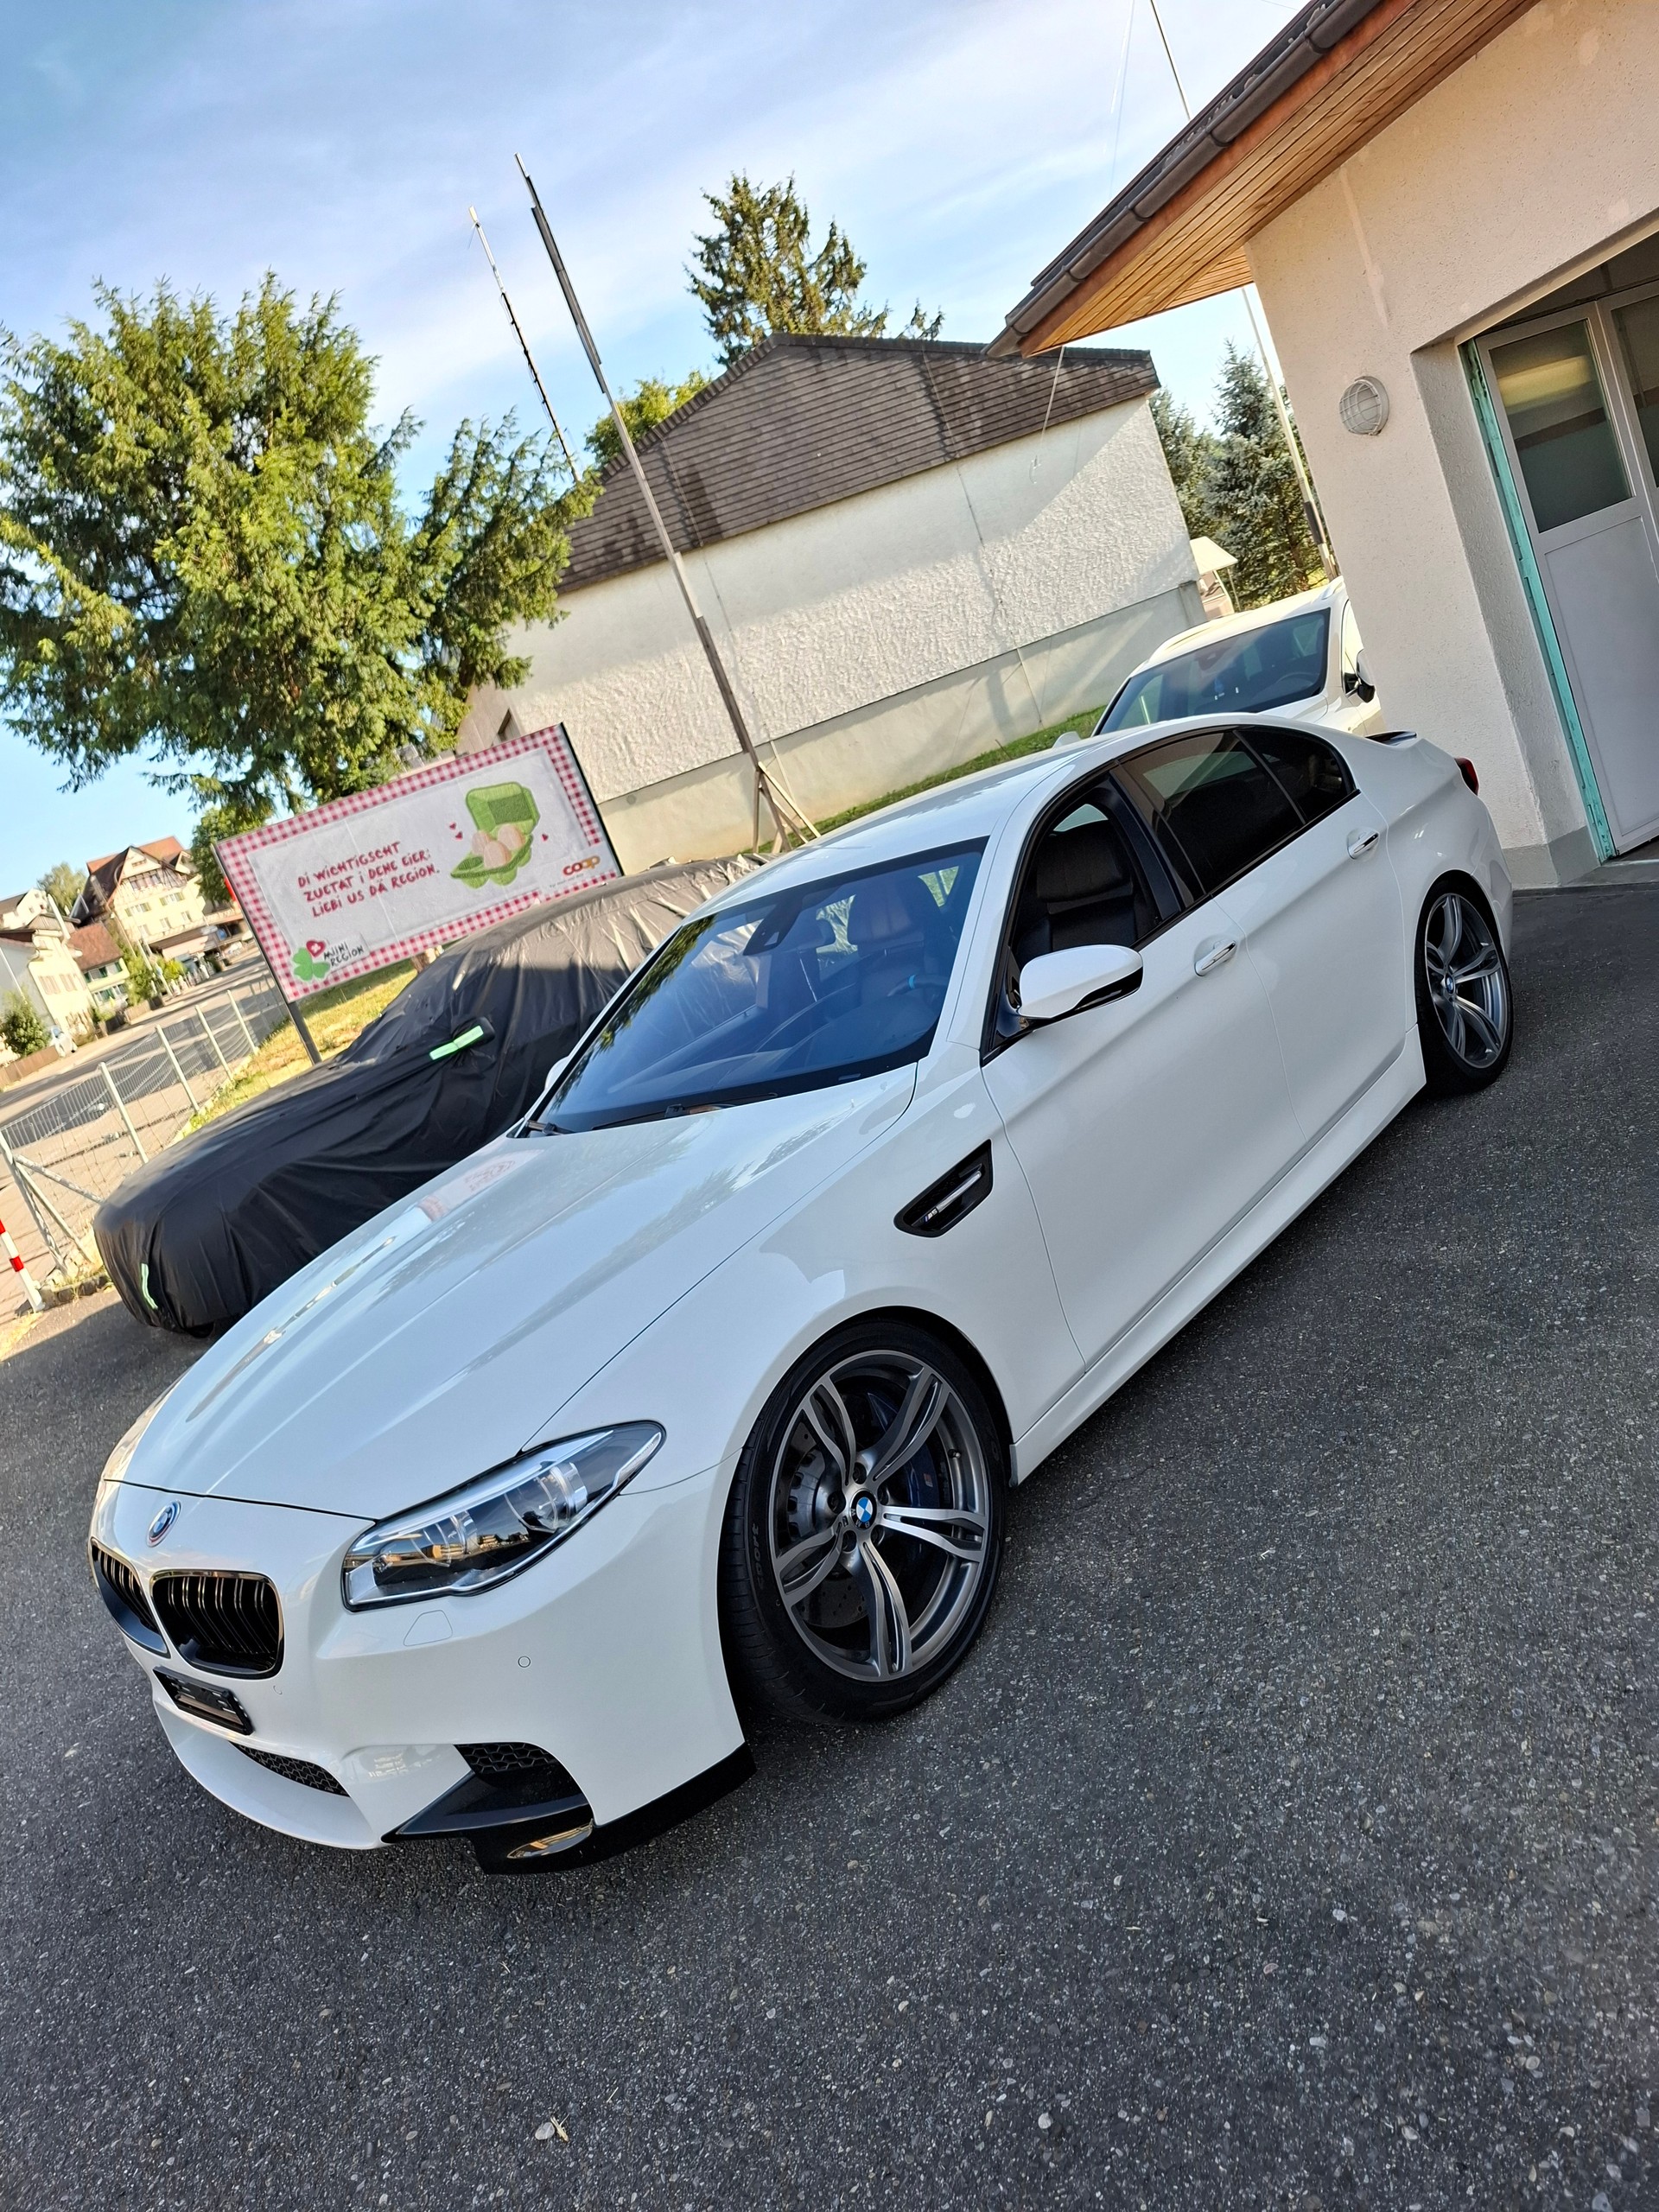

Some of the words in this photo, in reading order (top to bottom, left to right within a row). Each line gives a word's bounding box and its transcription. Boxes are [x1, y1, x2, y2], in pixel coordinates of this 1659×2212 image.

[563, 855, 601, 875] coop
[304, 875, 353, 901] ZUETAT
[368, 861, 397, 879] DENE
[346, 890, 365, 904] US
[369, 879, 388, 896] DÄ
[330, 945, 364, 966] REGION
